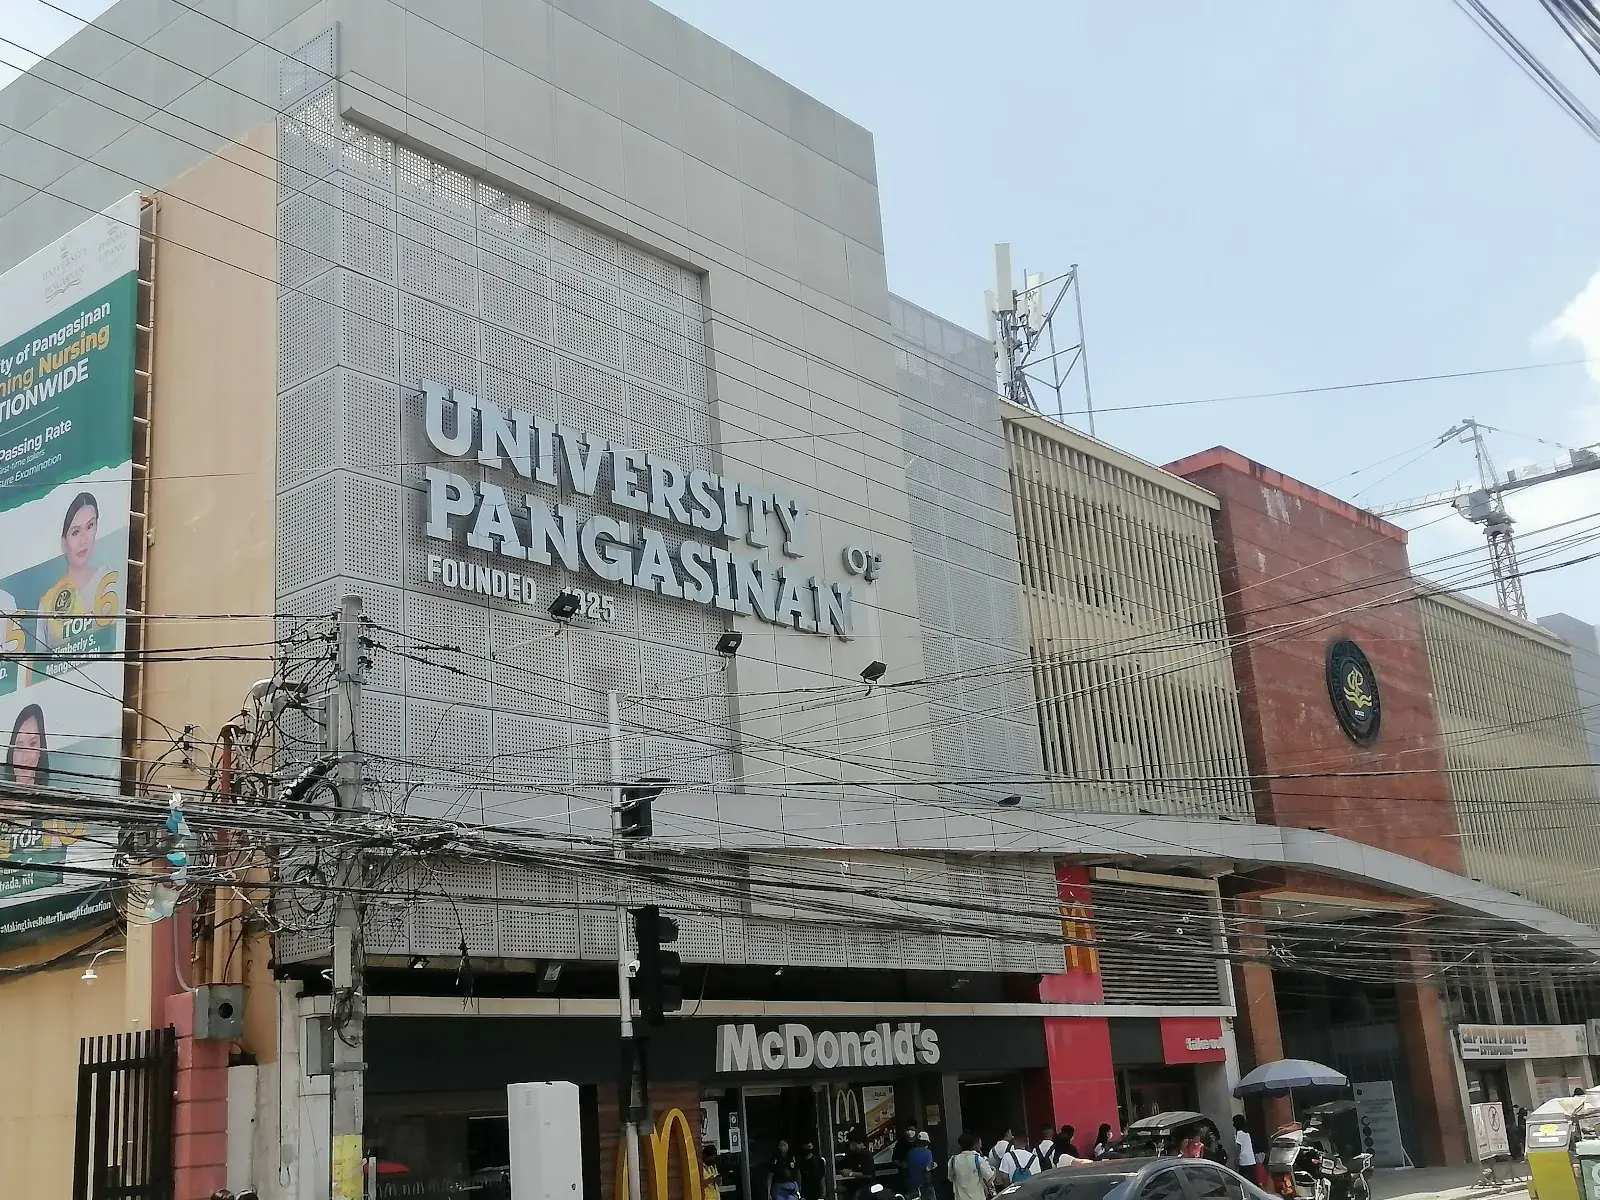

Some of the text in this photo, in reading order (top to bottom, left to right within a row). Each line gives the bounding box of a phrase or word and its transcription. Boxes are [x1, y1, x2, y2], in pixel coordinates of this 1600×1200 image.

[15, 344, 31, 365] of
[32, 301, 111, 357] Pangasinan
[39, 324, 110, 378] Nursing
[0, 357, 89, 422] TIONWIDE
[0, 419, 72, 461] Passing Rate
[15, 453, 62, 482] Examination
[418, 378, 810, 559] UNIVERSITY
[422, 466, 855, 642] PANGASINAN
[842, 544, 884, 584] OF
[62, 570, 119, 638] TOP 6
[426, 554, 616, 622] FOUNDED 925
[88, 633, 97, 646] S.
[11, 828, 42, 850] TOP
[716, 1022, 941, 1073] McDonald's
